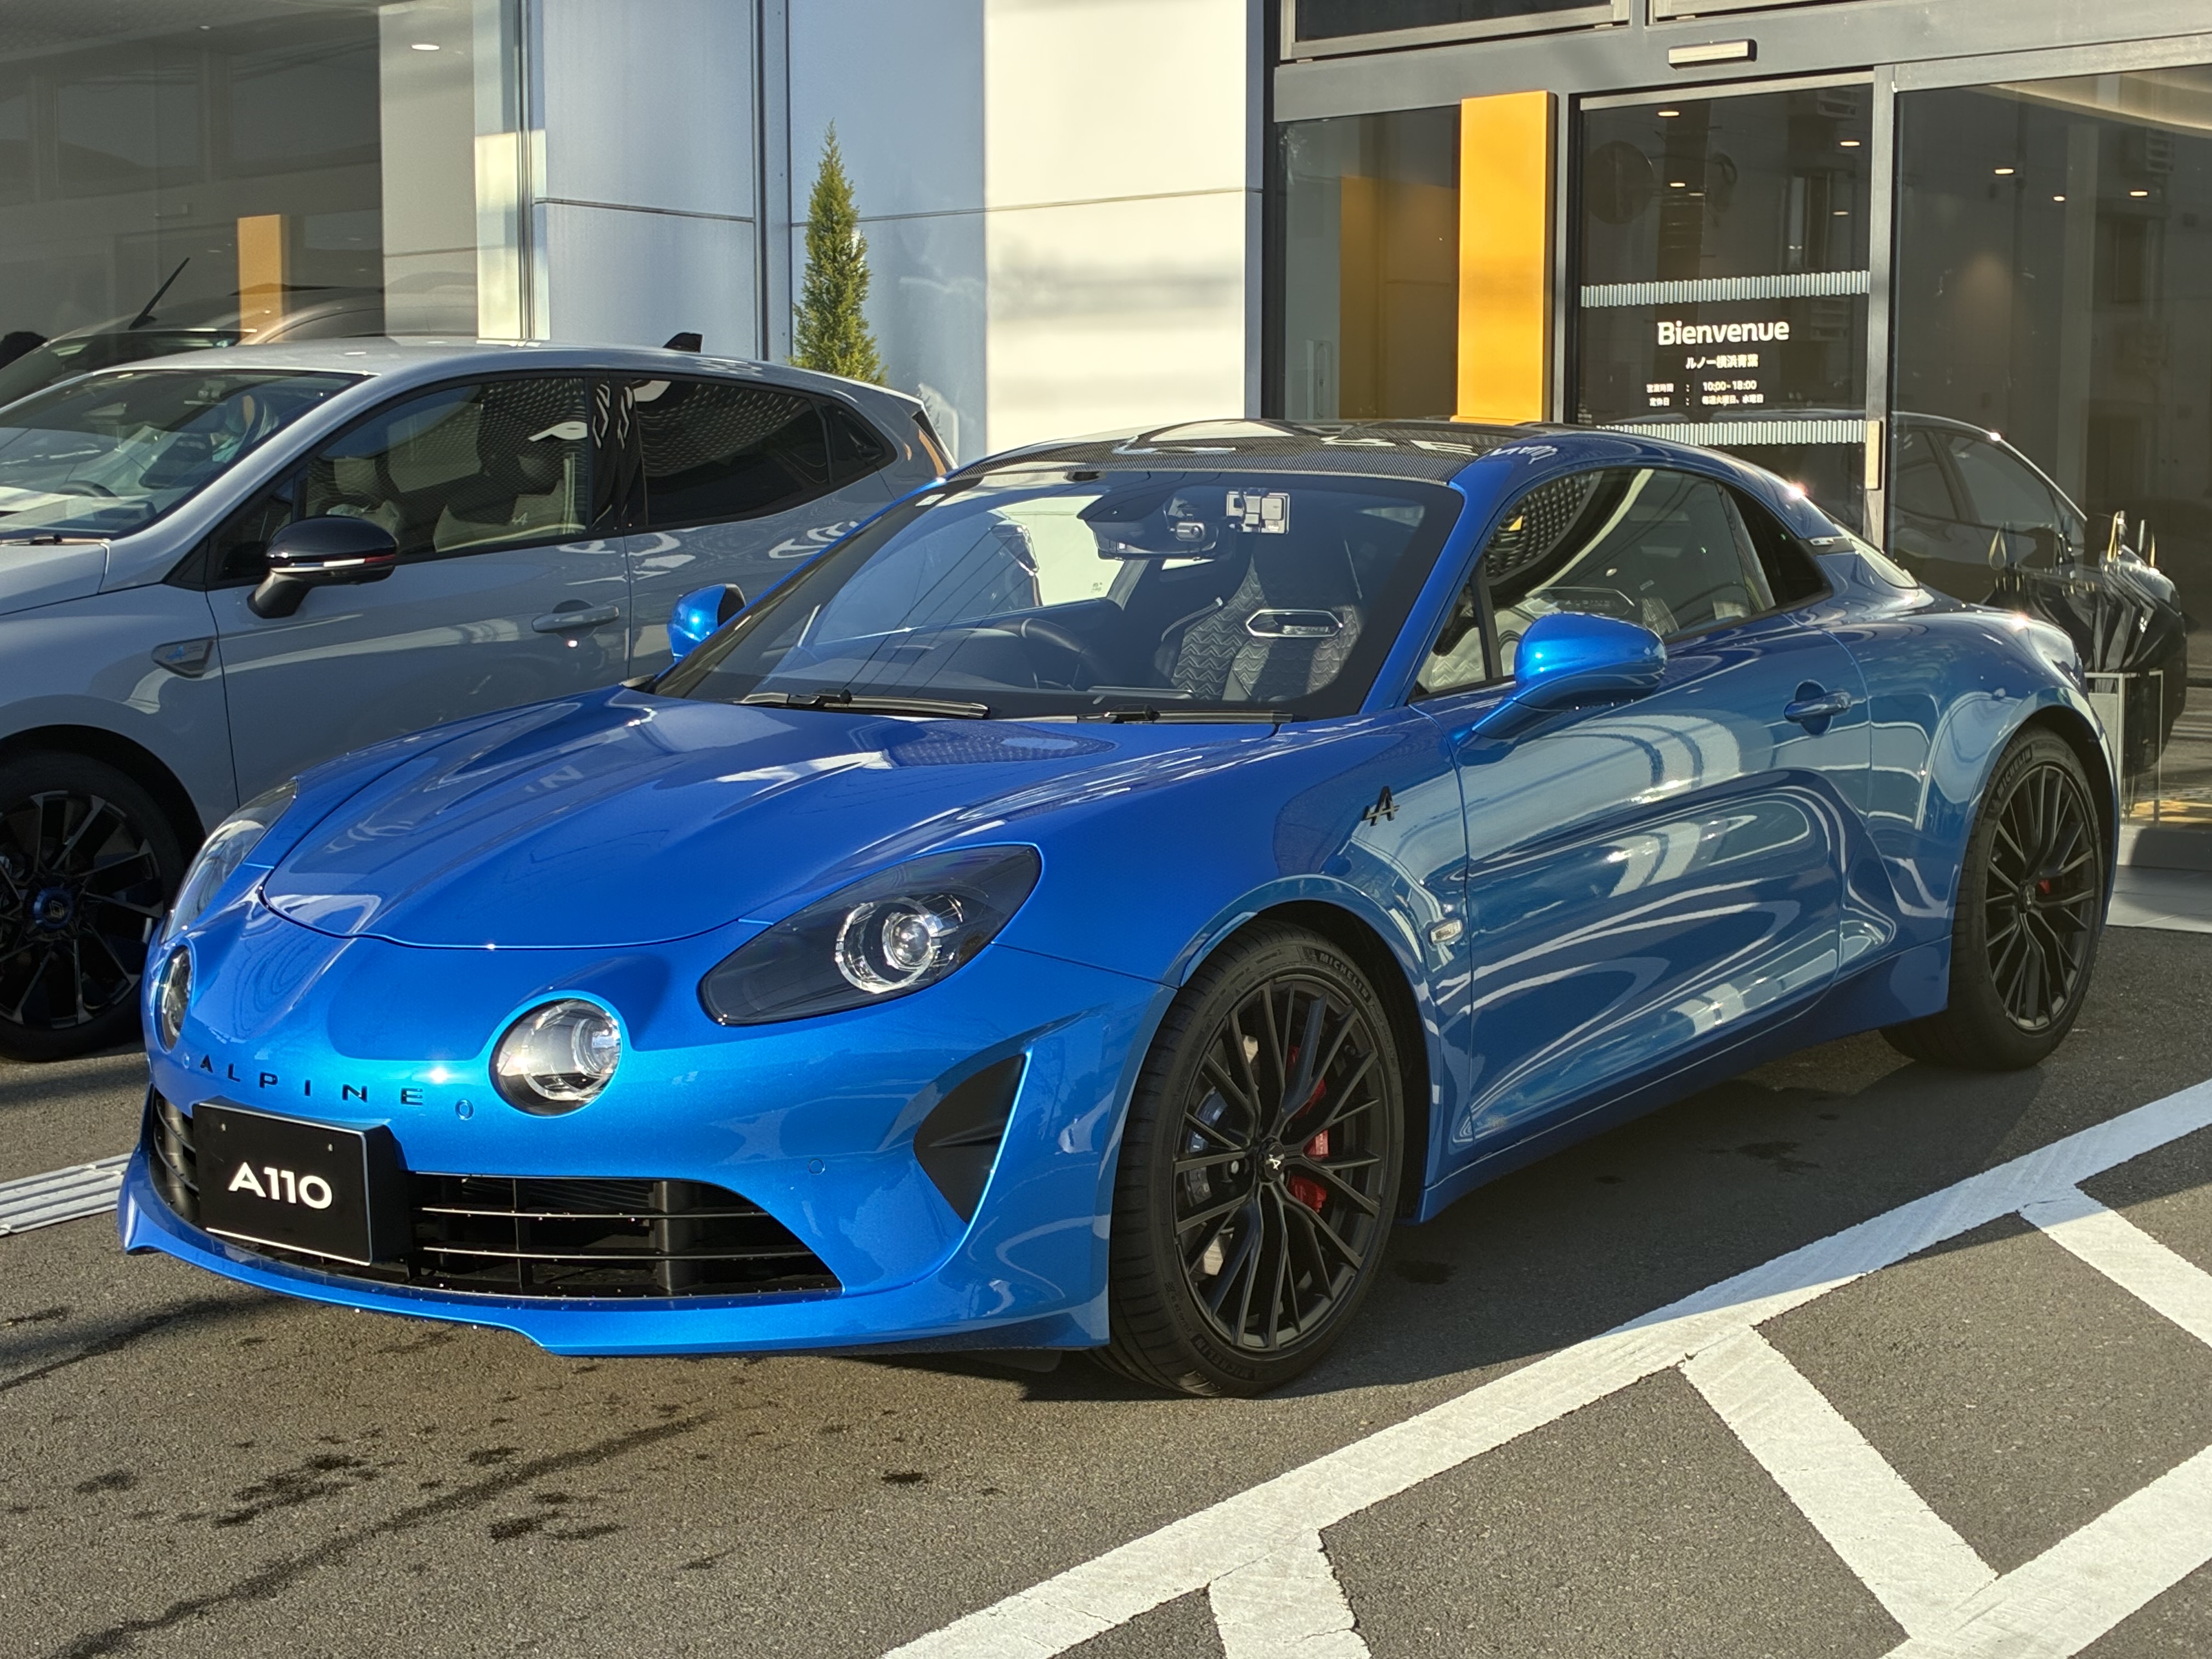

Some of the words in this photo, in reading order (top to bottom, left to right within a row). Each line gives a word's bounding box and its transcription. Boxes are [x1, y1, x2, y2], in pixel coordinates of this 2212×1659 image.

[1657, 320, 1790, 346] Bienvenue
[1996, 747, 2032, 799] MICHELIN
[1319, 952, 1370, 999] MICHELIN
[200, 1054, 424, 1105] ALPINE
[228, 1161, 332, 1209] A110
